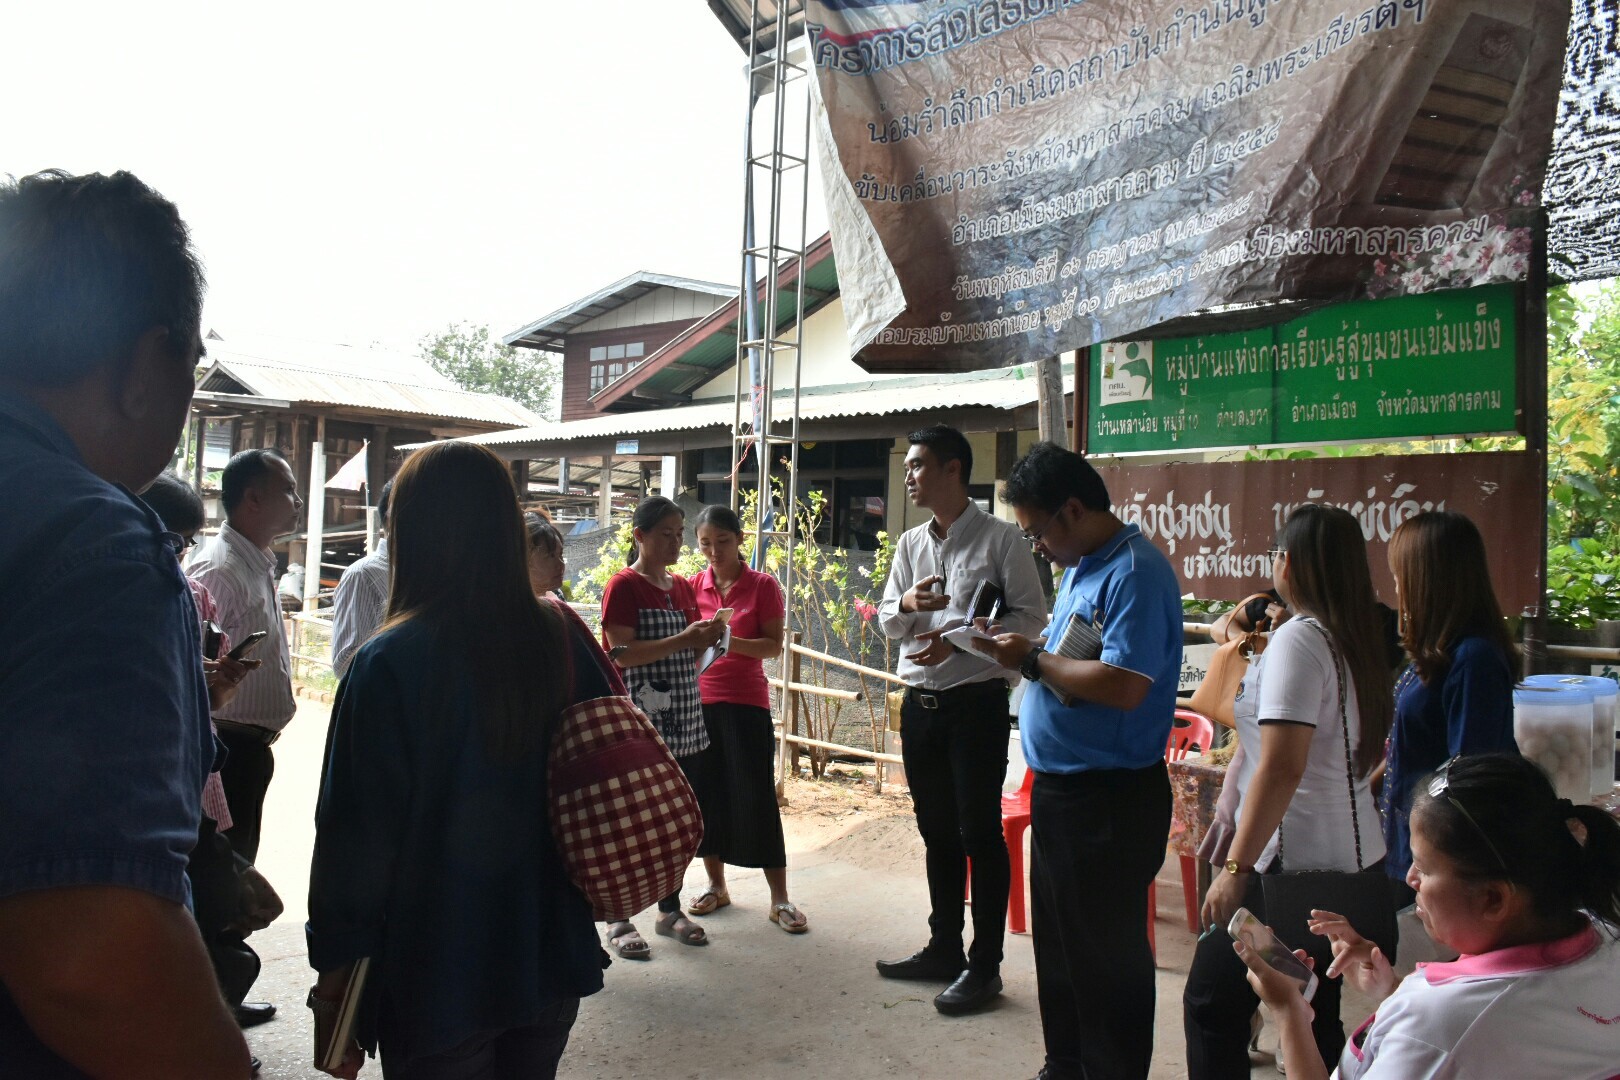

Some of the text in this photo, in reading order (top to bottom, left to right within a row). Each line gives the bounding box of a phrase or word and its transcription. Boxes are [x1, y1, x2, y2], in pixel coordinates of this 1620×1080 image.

[951, 158, 1180, 246] อำเภอเมืองมหาสารคาม
[1186, 136, 1208, 179] ปี
[951, 248, 1058, 300] วันพฤหัสบดีที่
[1097, 411, 1158, 436] บ้านเหล่าน้อย
[1216, 402, 1269, 428] ตำบลเขวา
[1292, 393, 1357, 423] อำเภอเมือง
[1376, 389, 1501, 417] จังหวัดมหาสารคาม
